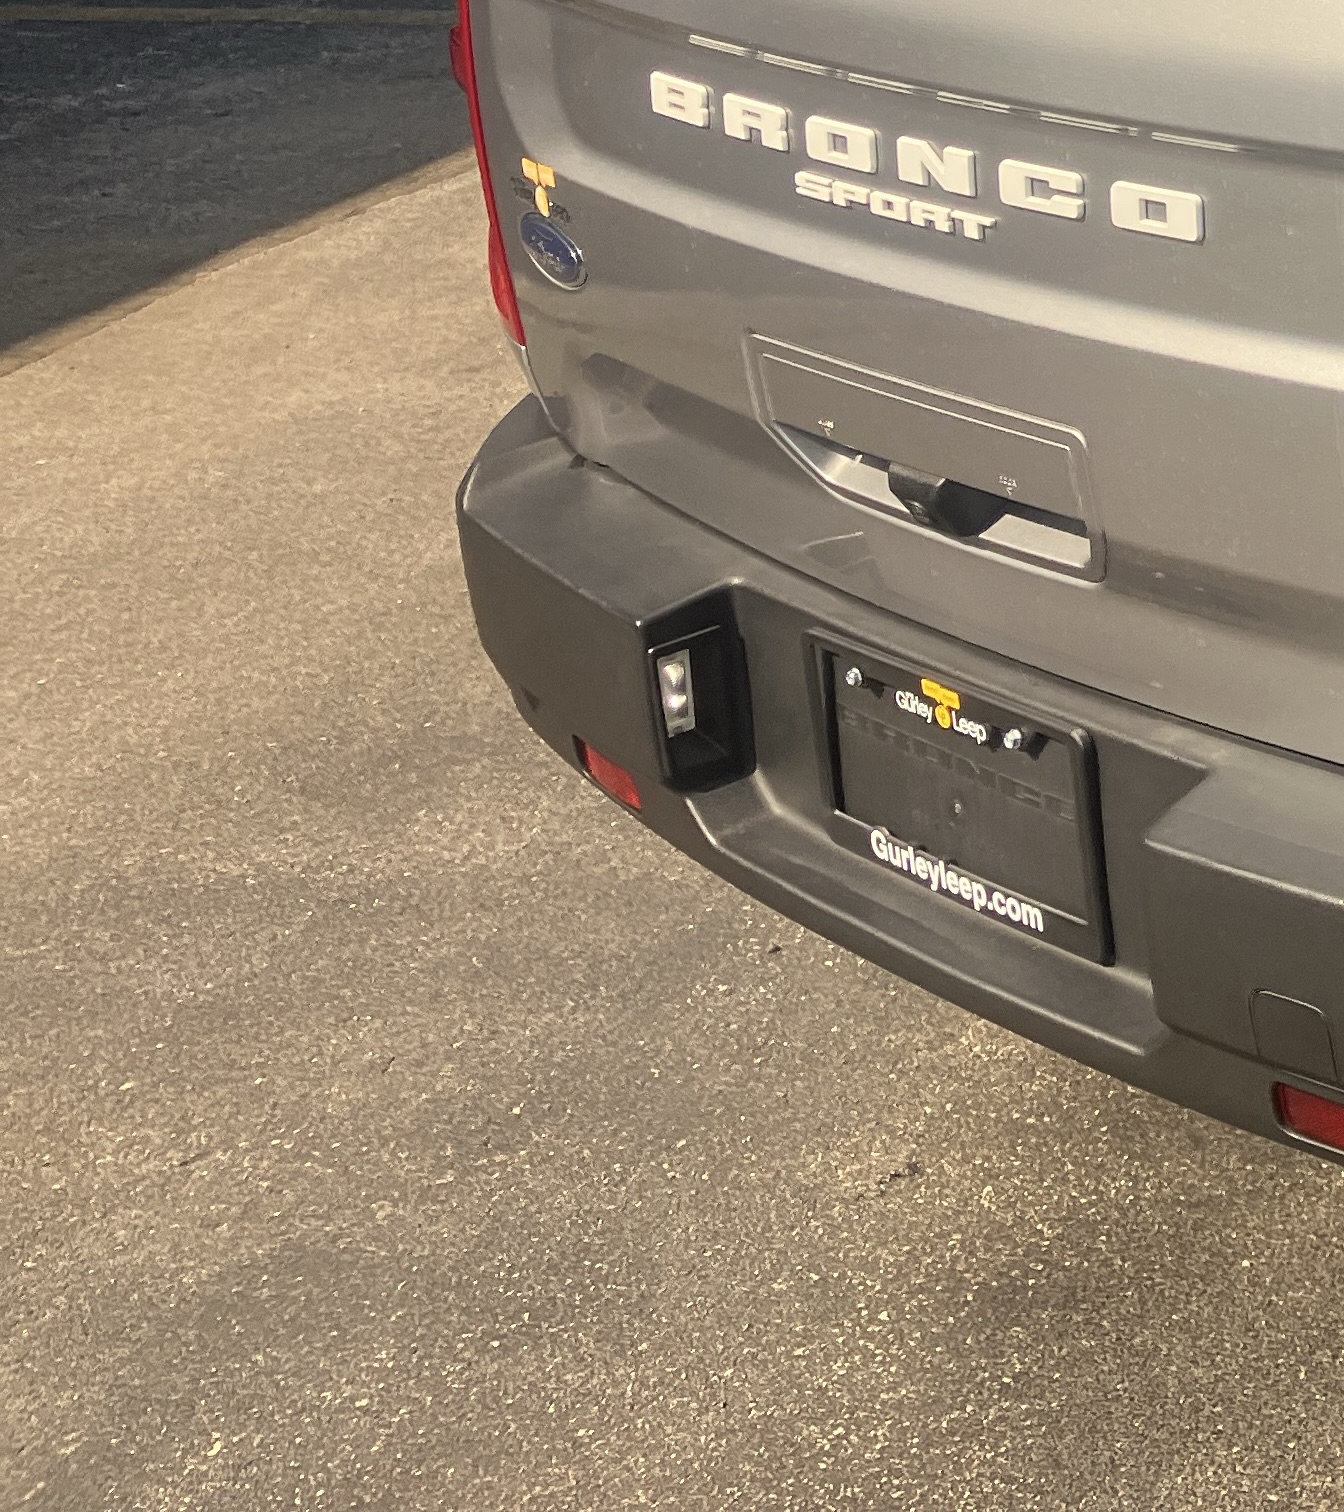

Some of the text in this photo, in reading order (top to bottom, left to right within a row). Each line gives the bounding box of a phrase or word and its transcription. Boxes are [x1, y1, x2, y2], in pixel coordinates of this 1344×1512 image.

[650, 70, 1205, 245] BRONCO
[794, 170, 997, 241] SPORT
[951, 709, 987, 745] Leep
[870, 829, 1044, 933] Gurleyleep.com
